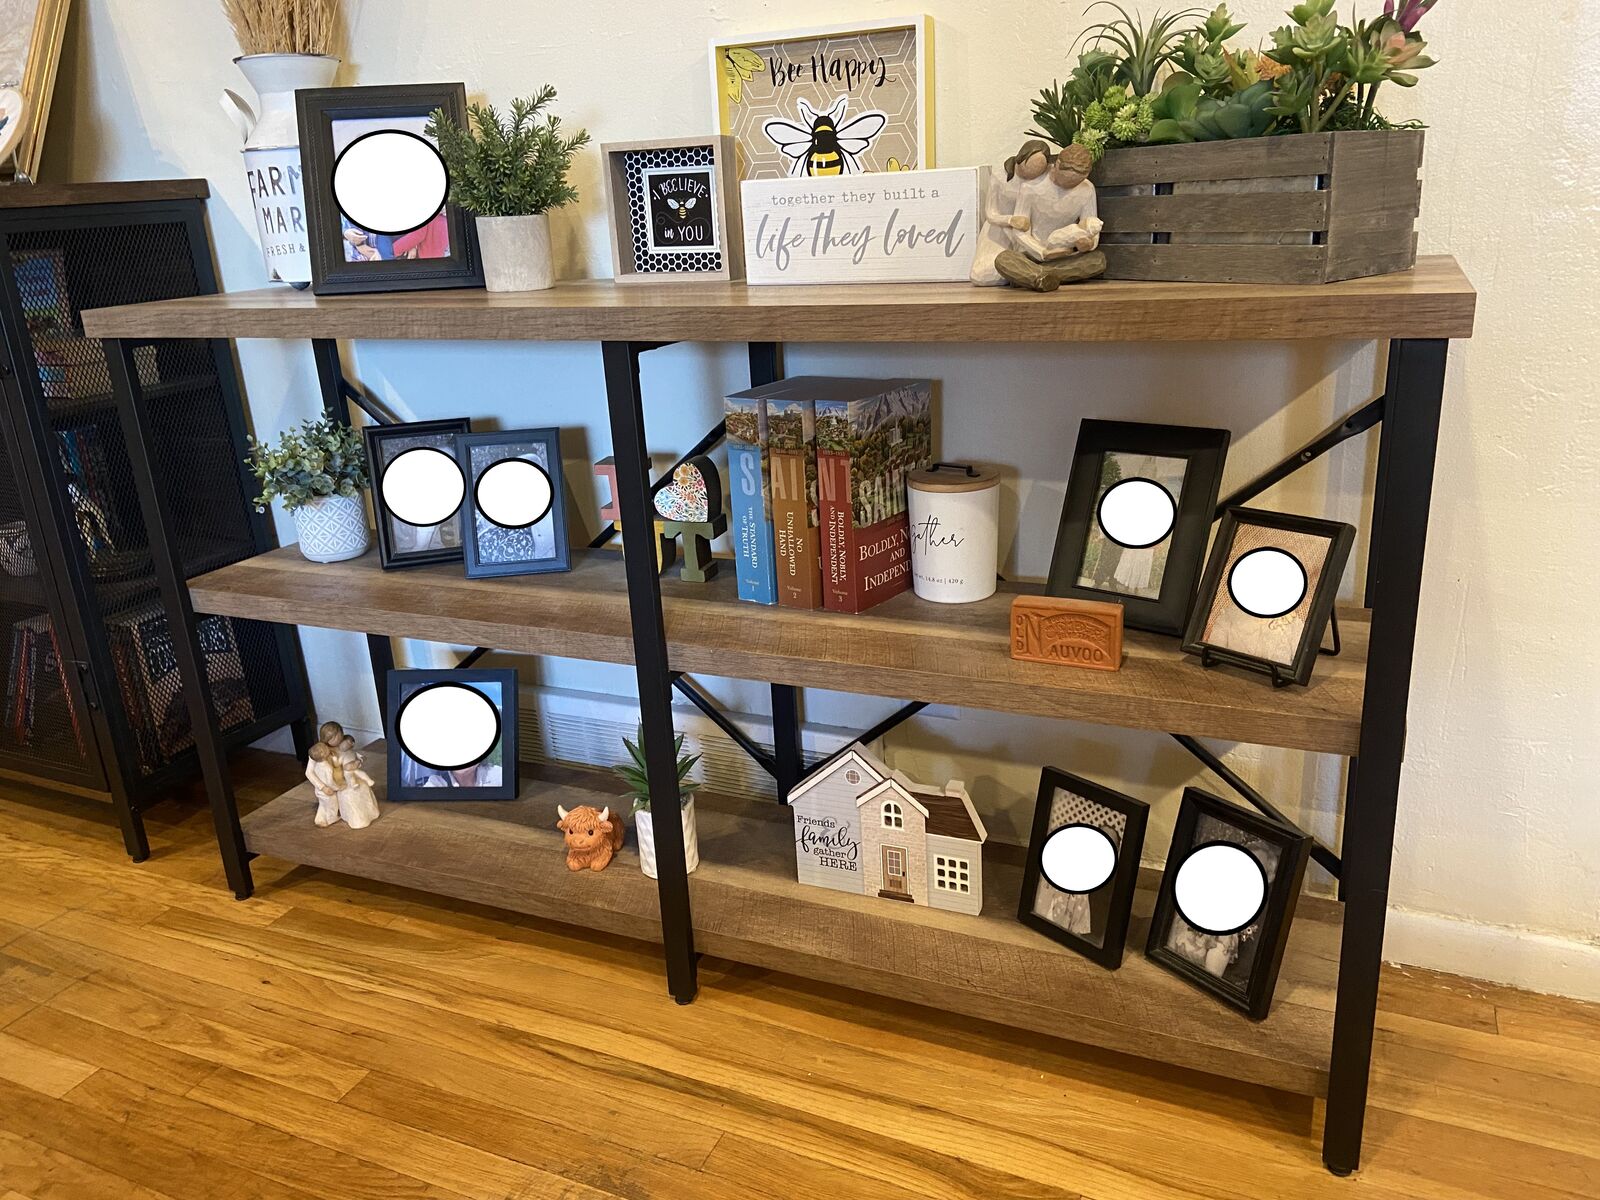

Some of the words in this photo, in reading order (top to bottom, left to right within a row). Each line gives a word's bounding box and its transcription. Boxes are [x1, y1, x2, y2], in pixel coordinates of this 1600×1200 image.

[769, 56, 804, 87] Bee
[811, 53, 896, 91] Happy
[658, 177, 707, 199] BEELIEVE
[771, 194, 836, 207] together
[842, 191, 876, 204] they
[883, 188, 926, 201] built
[931, 189, 940, 199] a
[664, 227, 675, 239] in
[677, 225, 703, 241] YOU
[755, 213, 806, 271] life
[811, 208, 876, 265] they
[883, 208, 965, 258] loved
[266, 243, 296, 257] FRESH
[741, 525, 750, 558] TRUTH
[749, 522, 758, 569] STANDARD
[779, 529, 787, 557] HAND
[786, 511, 796, 577] UNHALLOWED
[796, 537, 804, 553] NO
[828, 521, 839, 585] INDEPENDENT
[859, 533, 899, 561] BOLDLY,
[889, 547, 906, 562] AND
[796, 814, 836, 828] Friends
[795, 825, 861, 861] family
[813, 847, 846, 858] gather
[819, 856, 857, 871] HERE
